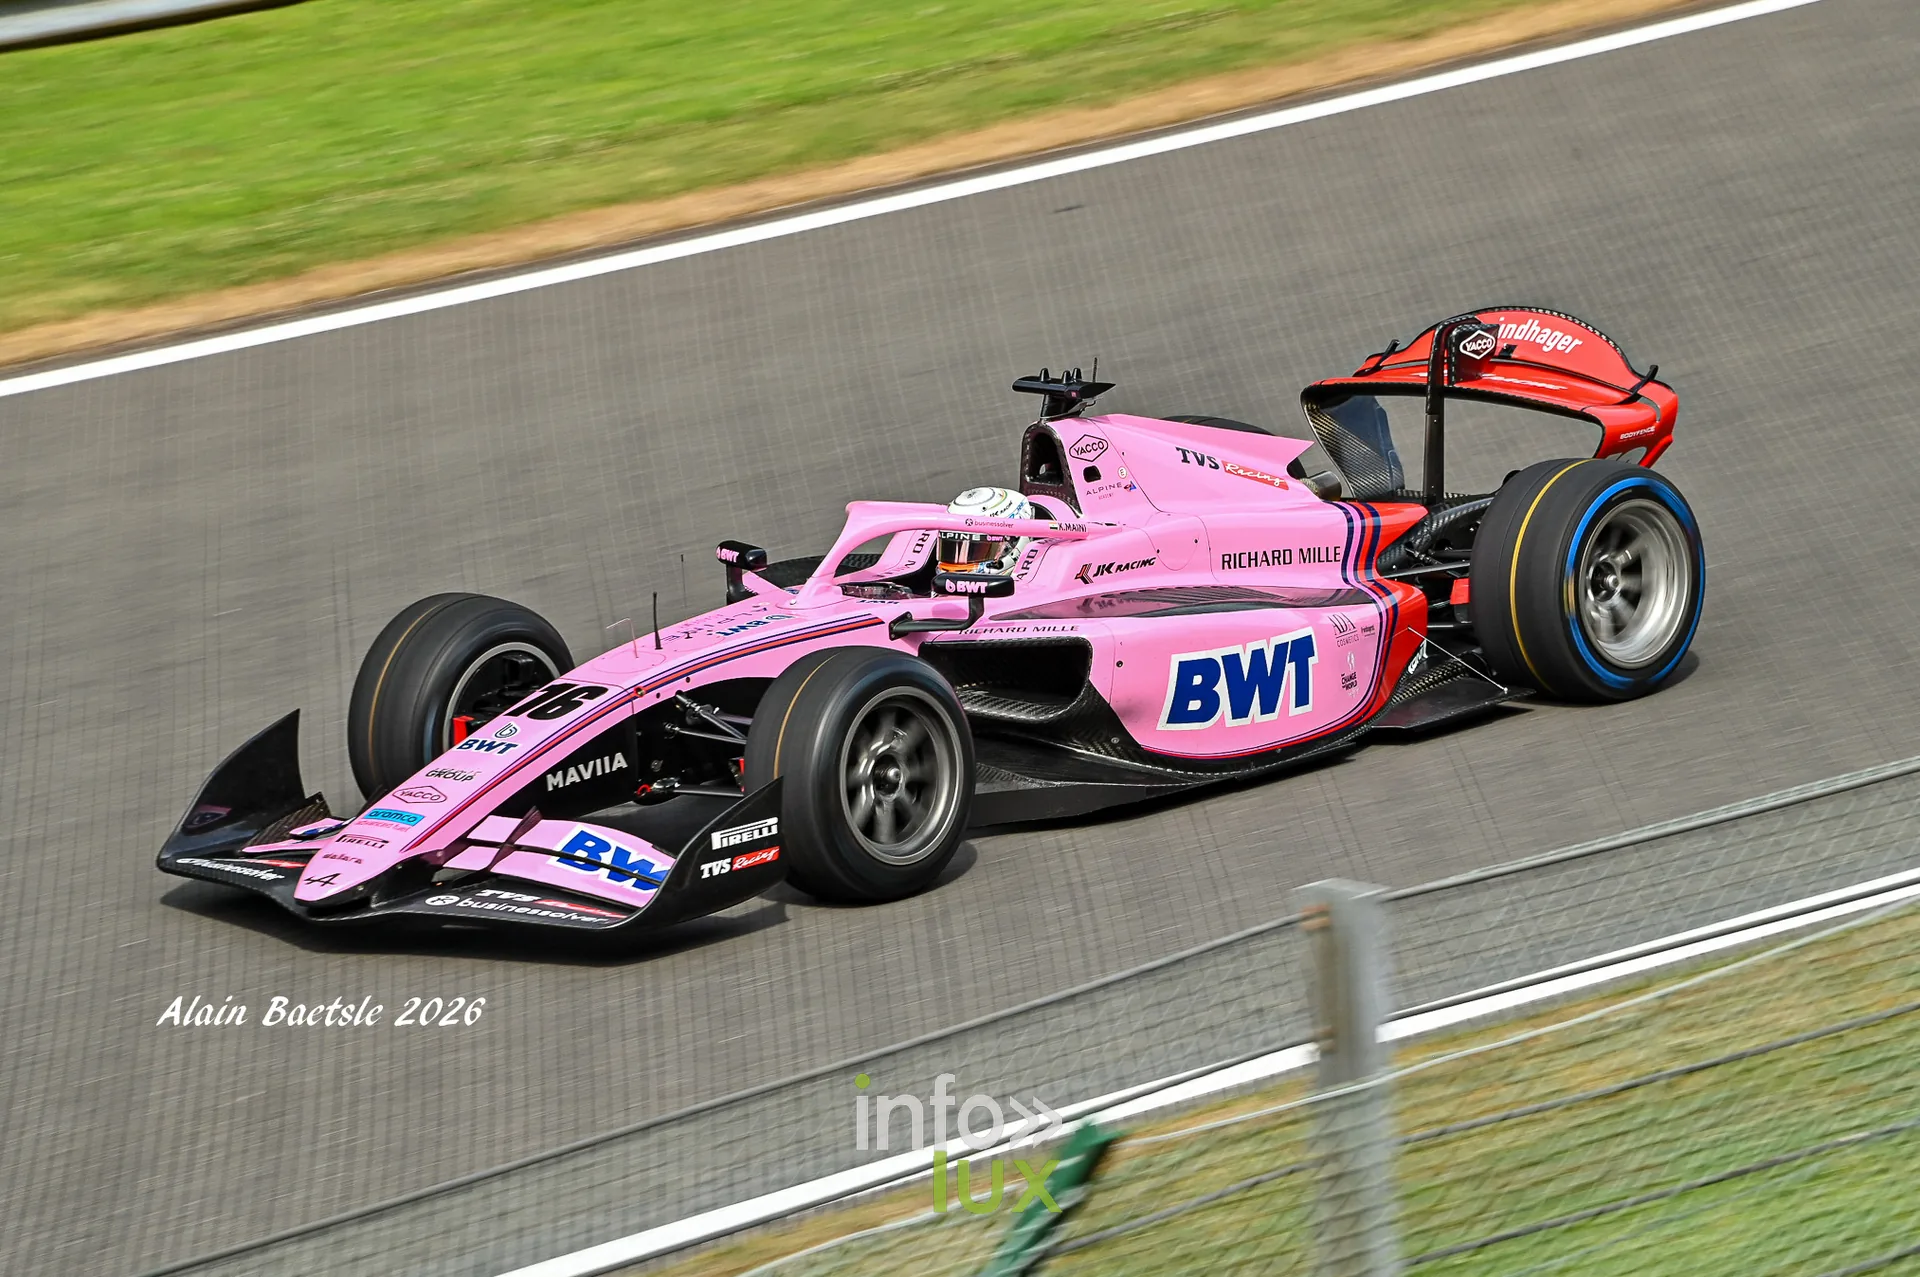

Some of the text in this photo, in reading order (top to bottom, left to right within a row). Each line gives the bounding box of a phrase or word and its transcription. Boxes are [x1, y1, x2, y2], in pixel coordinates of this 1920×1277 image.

[1465, 337, 1493, 353] YACCO
[1074, 440, 1105, 456] YACCO
[1175, 446, 1285, 487] TVS Racing
[1086, 482, 1123, 496] ALPINE
[974, 520, 1015, 529] businessolver
[1058, 523, 1087, 533] K.MAINI
[1221, 546, 1341, 570] RICHARD MILLE
[1093, 557, 1157, 578] JK RACING
[956, 581, 988, 593] BWT
[1165, 633, 1316, 725] BWT
[503, 683, 609, 721] 16
[456, 739, 518, 755] BWT
[425, 769, 475, 782] GROUP
[546, 752, 628, 792] MAVIIA
[400, 790, 441, 802] YACCO
[369, 810, 418, 823] aramco
[335, 833, 390, 849] PIRELLI
[711, 816, 779, 851] PIRELLI
[700, 847, 780, 880] TVS Racing
[475, 889, 542, 902] TVS
[456, 898, 609, 924] businessolver
